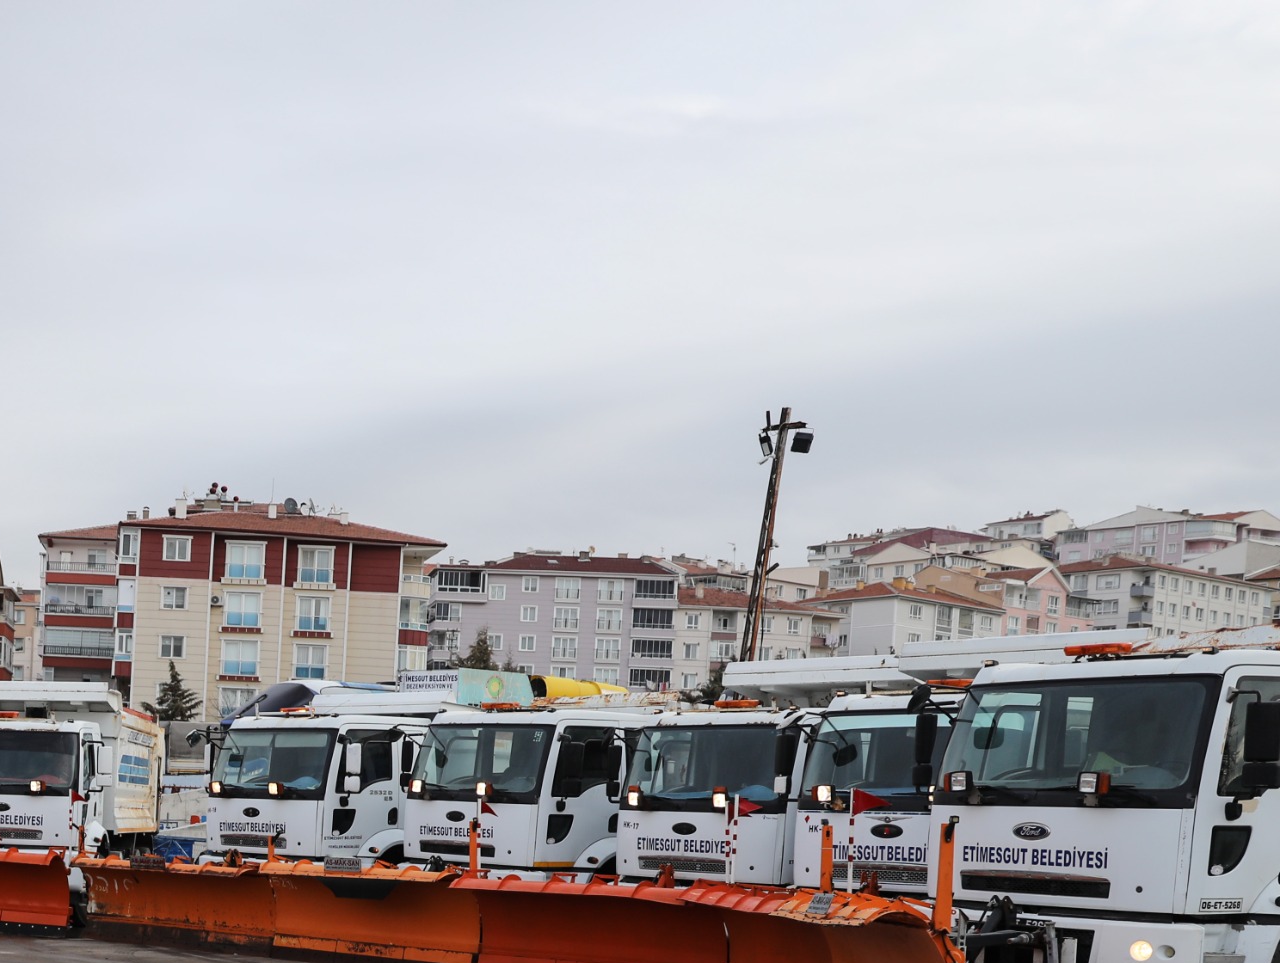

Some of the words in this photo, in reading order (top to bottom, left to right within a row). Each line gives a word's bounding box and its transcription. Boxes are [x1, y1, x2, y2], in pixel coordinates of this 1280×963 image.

[430, 673, 458, 682] BELEDİYES
[0, 813, 43, 826] BELEDİYESİ
[623, 821, 639, 829] HK-17
[219, 820, 250, 832] ETİMESGUT
[420, 823, 452, 836] ETİMESGUT
[454, 826, 494, 838] BELEESİ
[1020, 825, 1041, 836] Ford
[637, 835, 681, 852] ETİMESGUT
[832, 841, 886, 861] TİMESGUT
[887, 844, 928, 862] BELEDİ
[963, 843, 1028, 864] ETİMESGUT
[1031, 846, 1108, 869] BELEDİYESİ
[1201, 901, 1241, 909] 06-ET-5268
